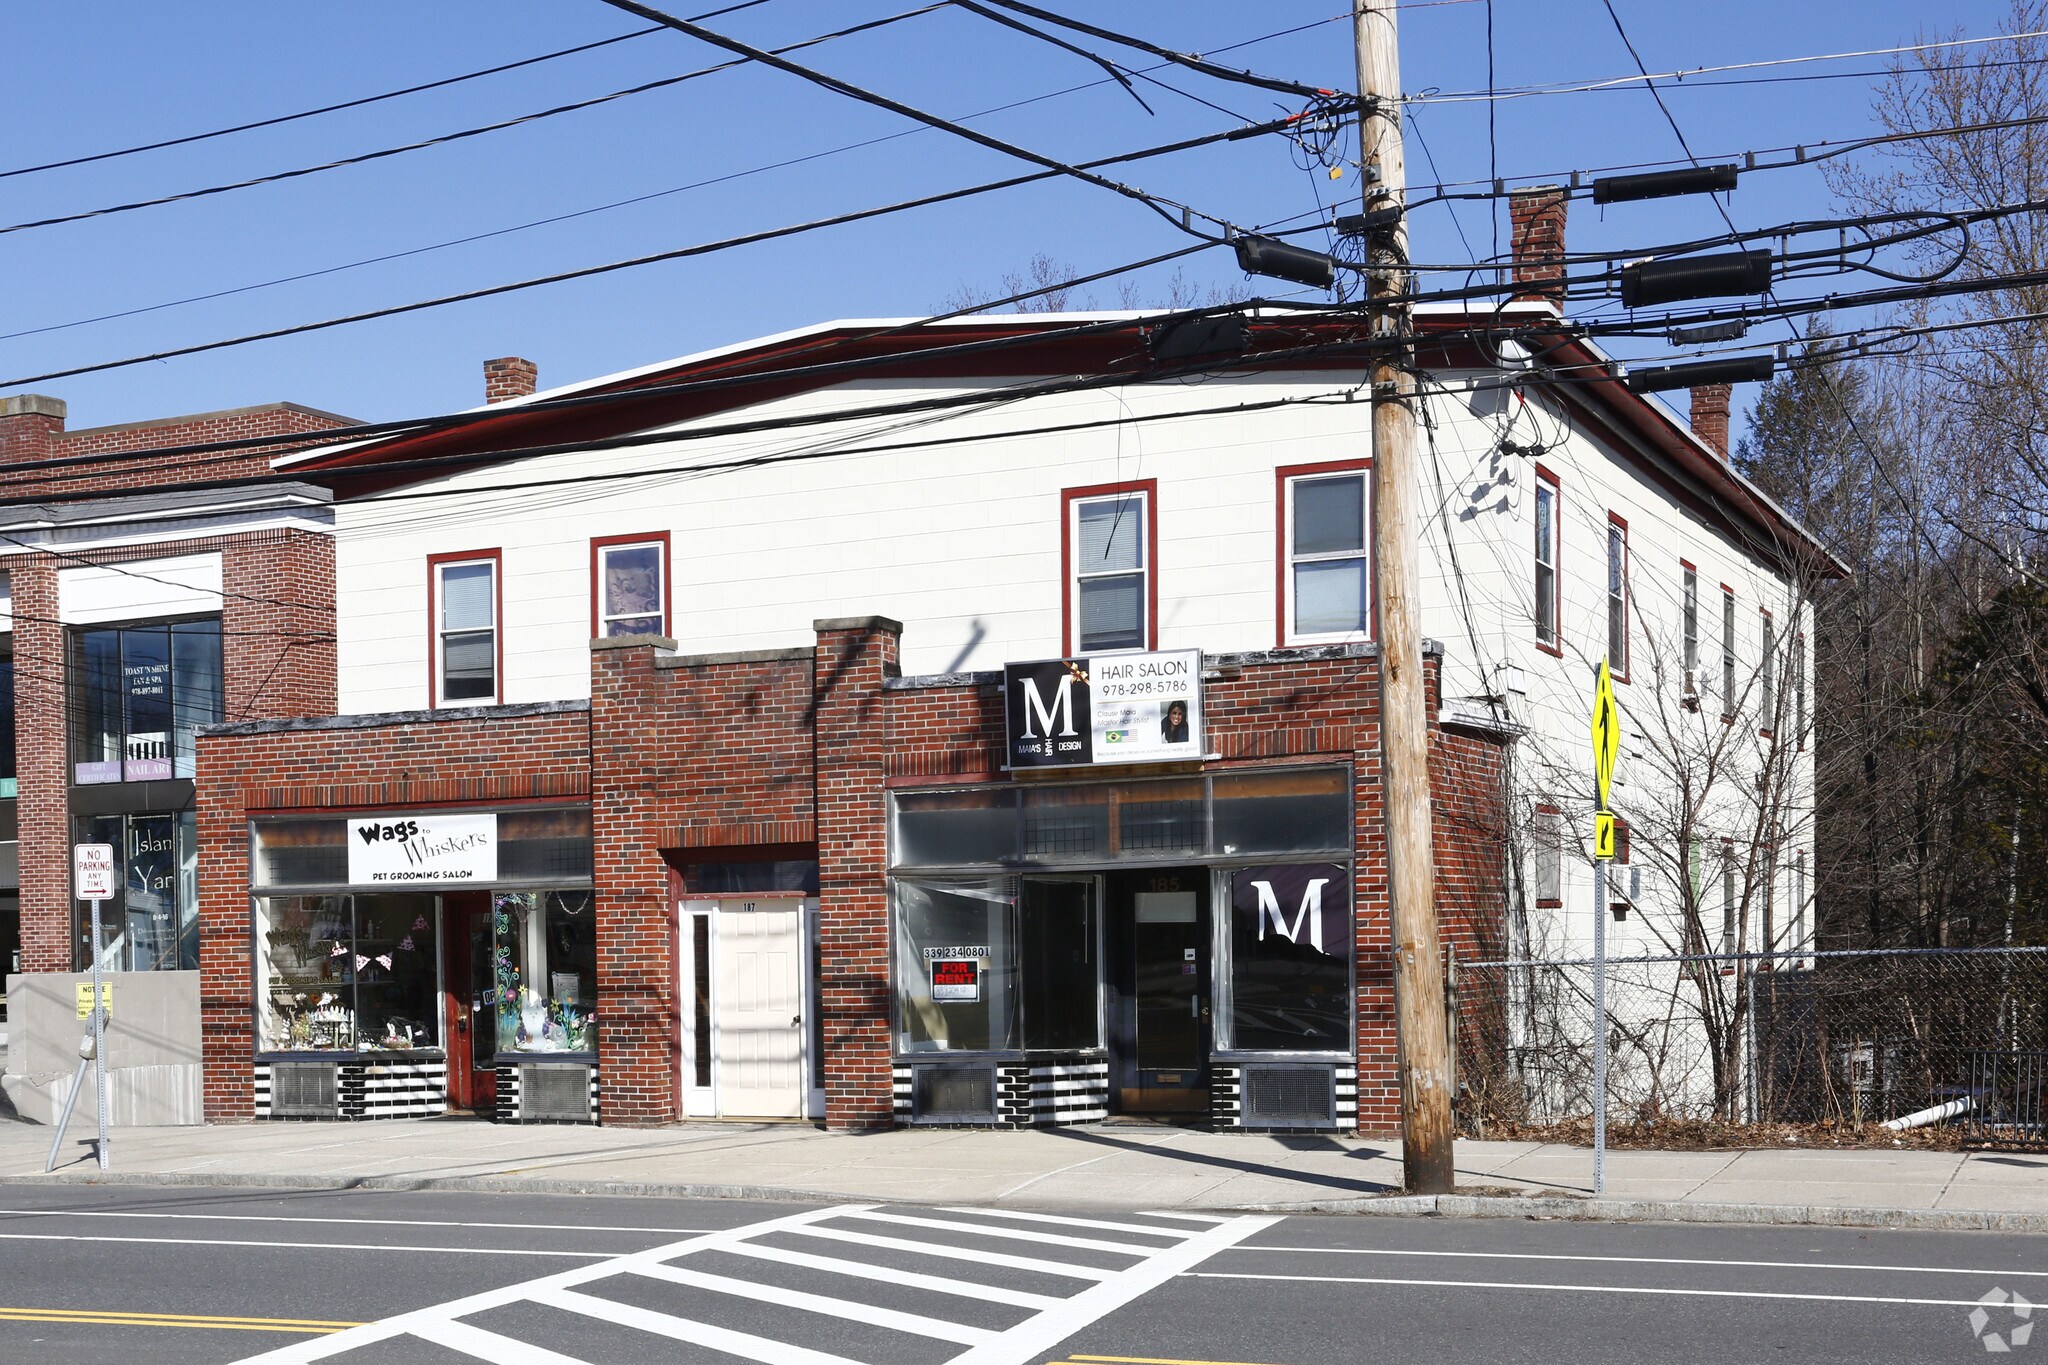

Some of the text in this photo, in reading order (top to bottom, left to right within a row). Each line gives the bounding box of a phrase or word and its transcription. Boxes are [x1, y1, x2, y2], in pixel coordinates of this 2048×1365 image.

[125, 666, 144, 676] TOAST
[1101, 660, 1187, 680] HAIR SALON
[151, 675, 162, 683] SPA
[1102, 679, 1188, 697] 978-298-5786
[1018, 674, 1079, 739] M
[1044, 738, 1054, 757] HAIR
[1058, 741, 1082, 751] DESIGN
[91, 763, 106, 771] GIFT
[128, 762, 171, 775] NAIL ART
[357, 820, 419, 846] Wags
[135, 829, 173, 856] Islan
[87, 850, 101, 860] NO
[402, 833, 488, 868] Whiskers
[79, 861, 110, 872] PARKING
[135, 865, 173, 894] Yar
[390, 871, 440, 880] GROOMING
[442, 870, 472, 879] SALON
[86, 880, 104, 888] TIME
[1150, 877, 1180, 892] 185
[743, 902, 756, 912] 187
[1250, 878, 1330, 955] M
[924, 947, 990, 958] 339 234 0801
[942, 963, 968, 973] FOR
[935, 973, 975, 984] RENT
